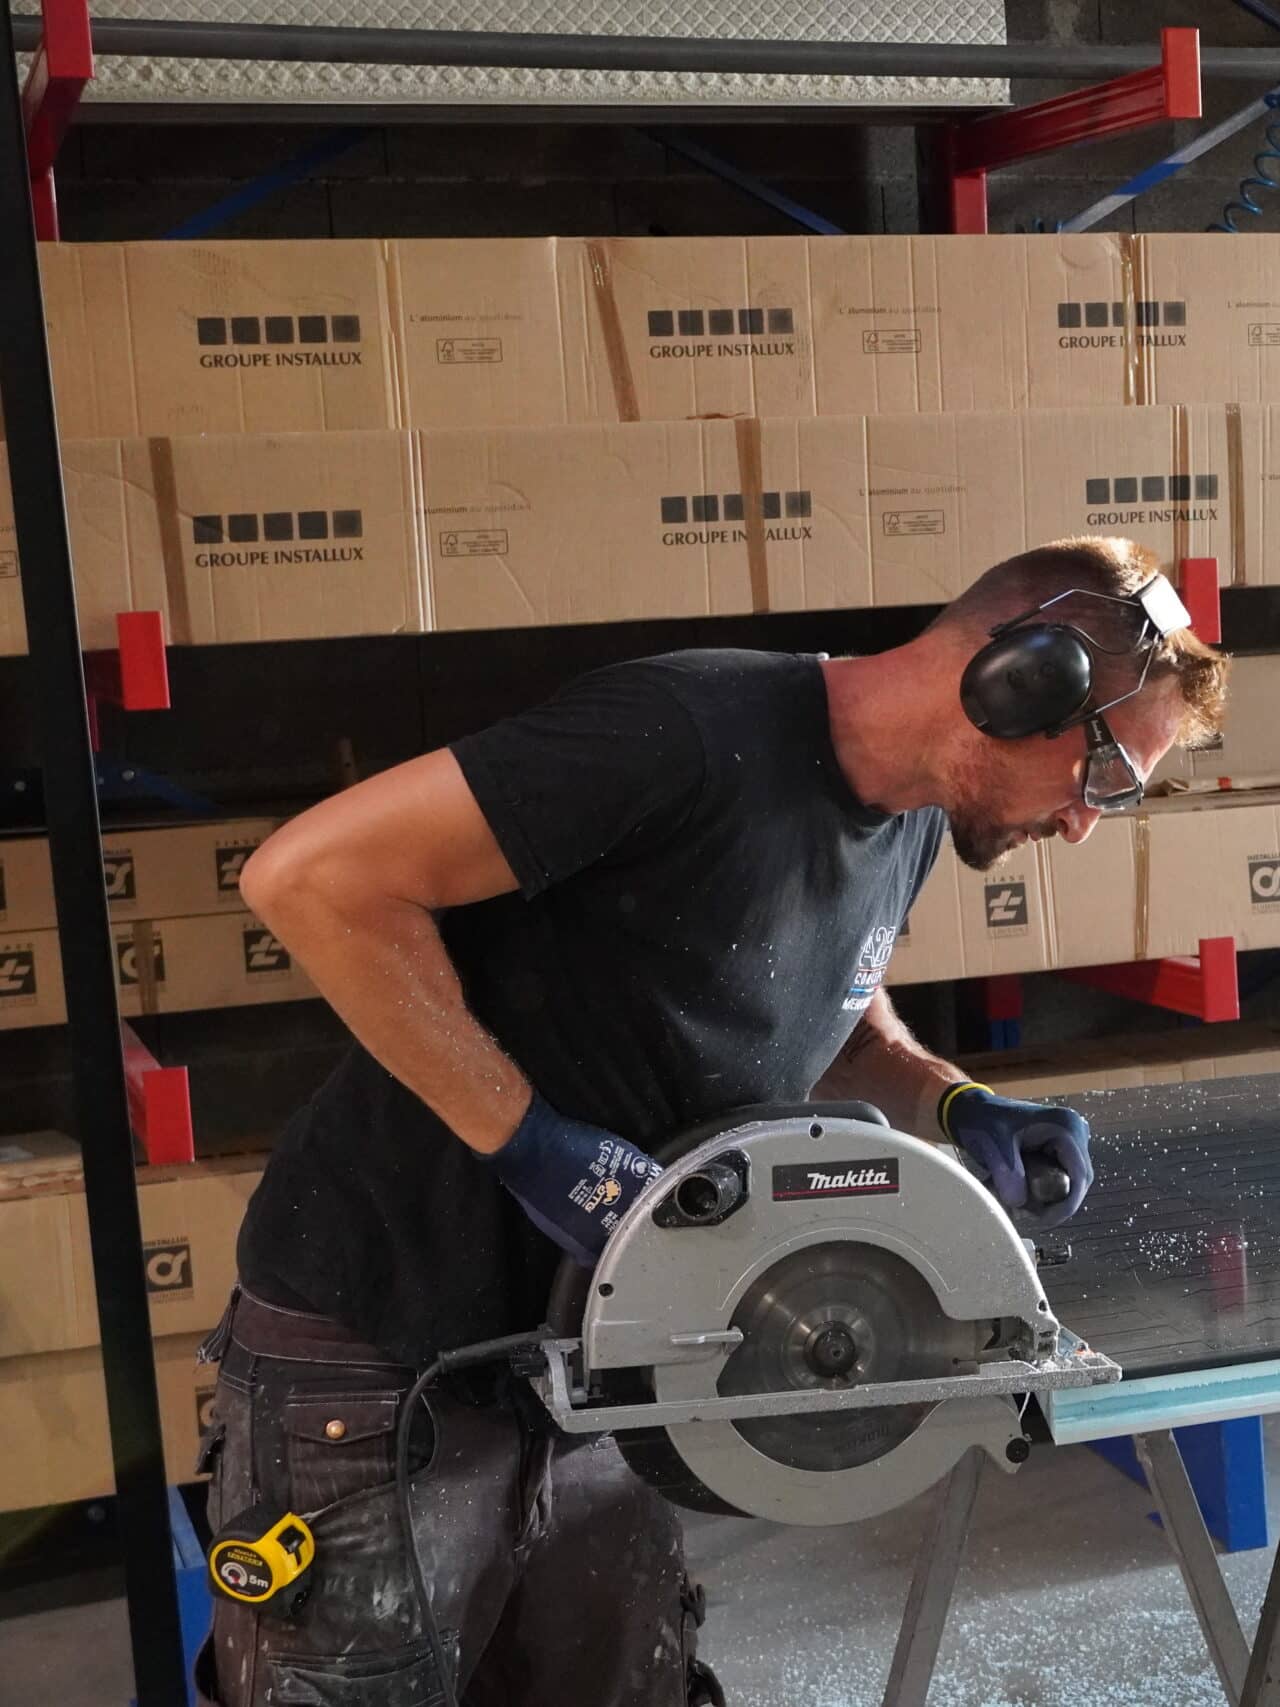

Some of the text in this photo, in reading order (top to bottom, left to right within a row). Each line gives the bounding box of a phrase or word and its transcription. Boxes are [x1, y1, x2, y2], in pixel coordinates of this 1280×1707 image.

[1059, 334, 1187, 349] GROUPE ITALLUX
[650, 342, 794, 359] GROUPE INSTALLUX
[199, 351, 362, 369] GROUPE INSTALLUX
[1086, 509, 1218, 526] GROUPE INSTALLUX
[661, 526, 813, 546] GROUPE INALLUX
[195, 547, 364, 569] GROUPE INSTALLUX
